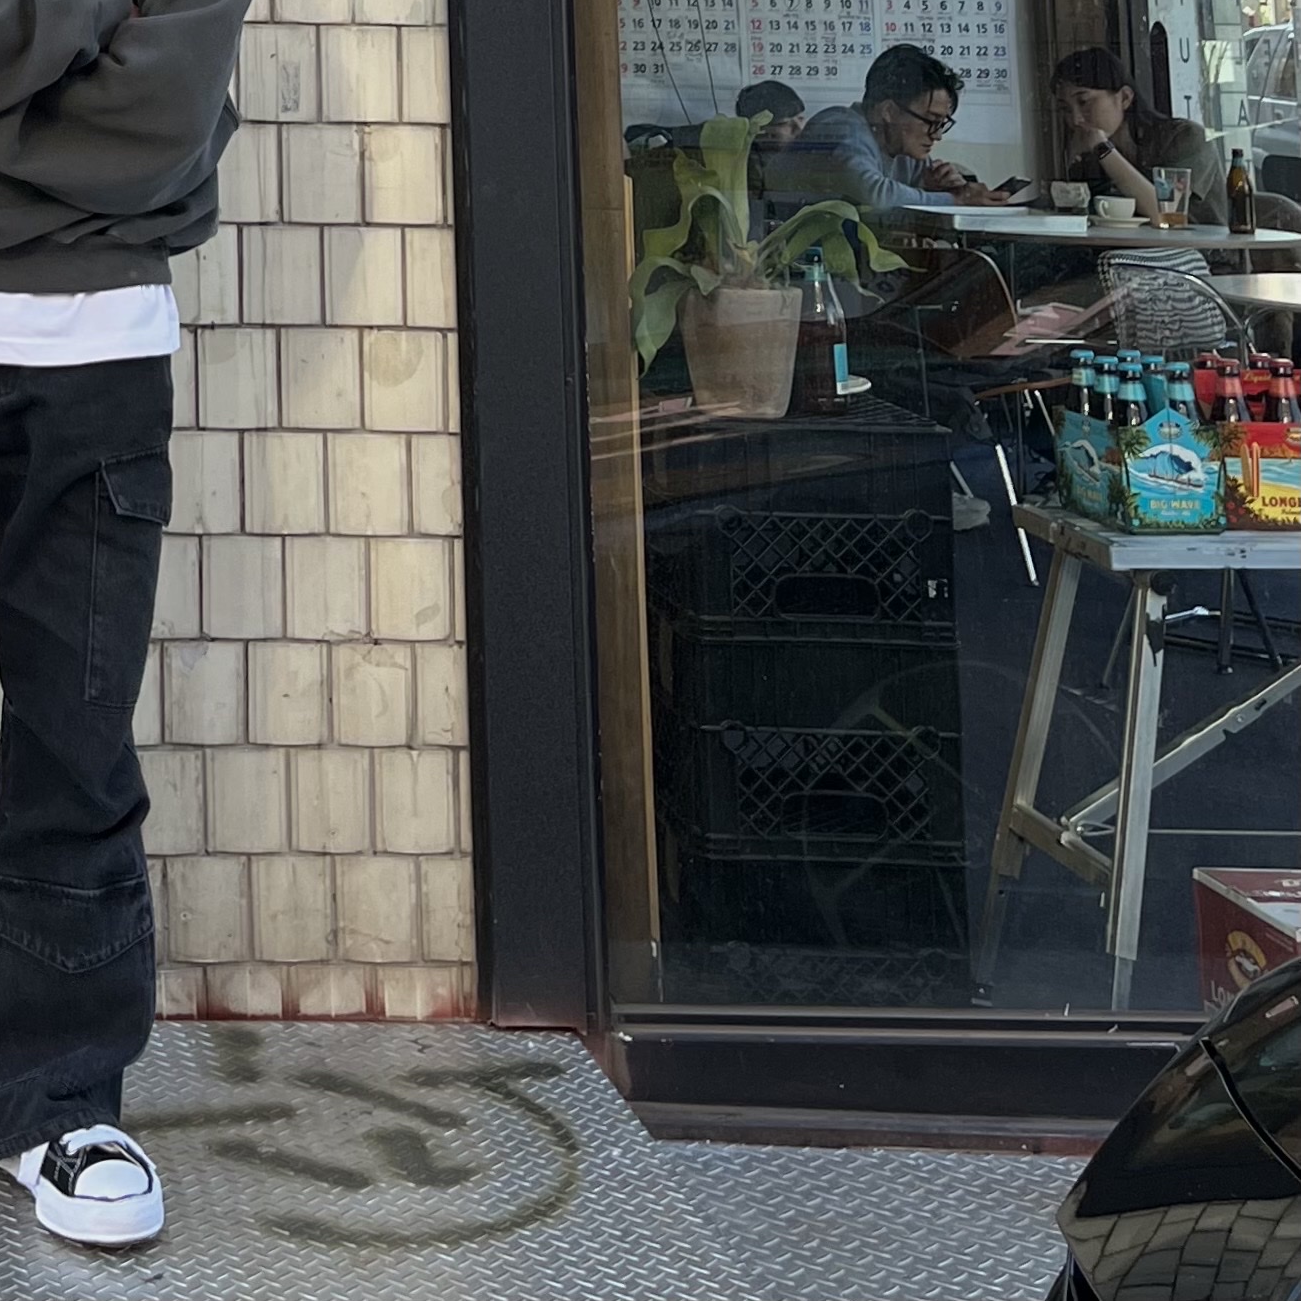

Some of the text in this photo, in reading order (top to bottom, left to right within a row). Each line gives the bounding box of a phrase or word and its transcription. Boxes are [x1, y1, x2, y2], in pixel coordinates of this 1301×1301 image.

[770, 0, 776, 7] 6
[789, 0, 794, 8] 7
[806, 0, 812, 8] 8
[824, 0, 830, 8] 9
[840, 0, 851, 9] 10
[859, 0, 868, 9] 11
[904, 0, 910, 10] 4
[922, 1, 928, 10] 5
[940, 1, 947, 10] 6
[959, 1, 965, 10] 7
[977, 1, 983, 11] 8
[995, 2, 1002, 11] 9
[751, 20, 870, 31] 12 13 14 15 16 17 18
[885, 23, 1004, 34] 10 11 12 13 14 15 16
[633, 64, 664, 73] 30 31
